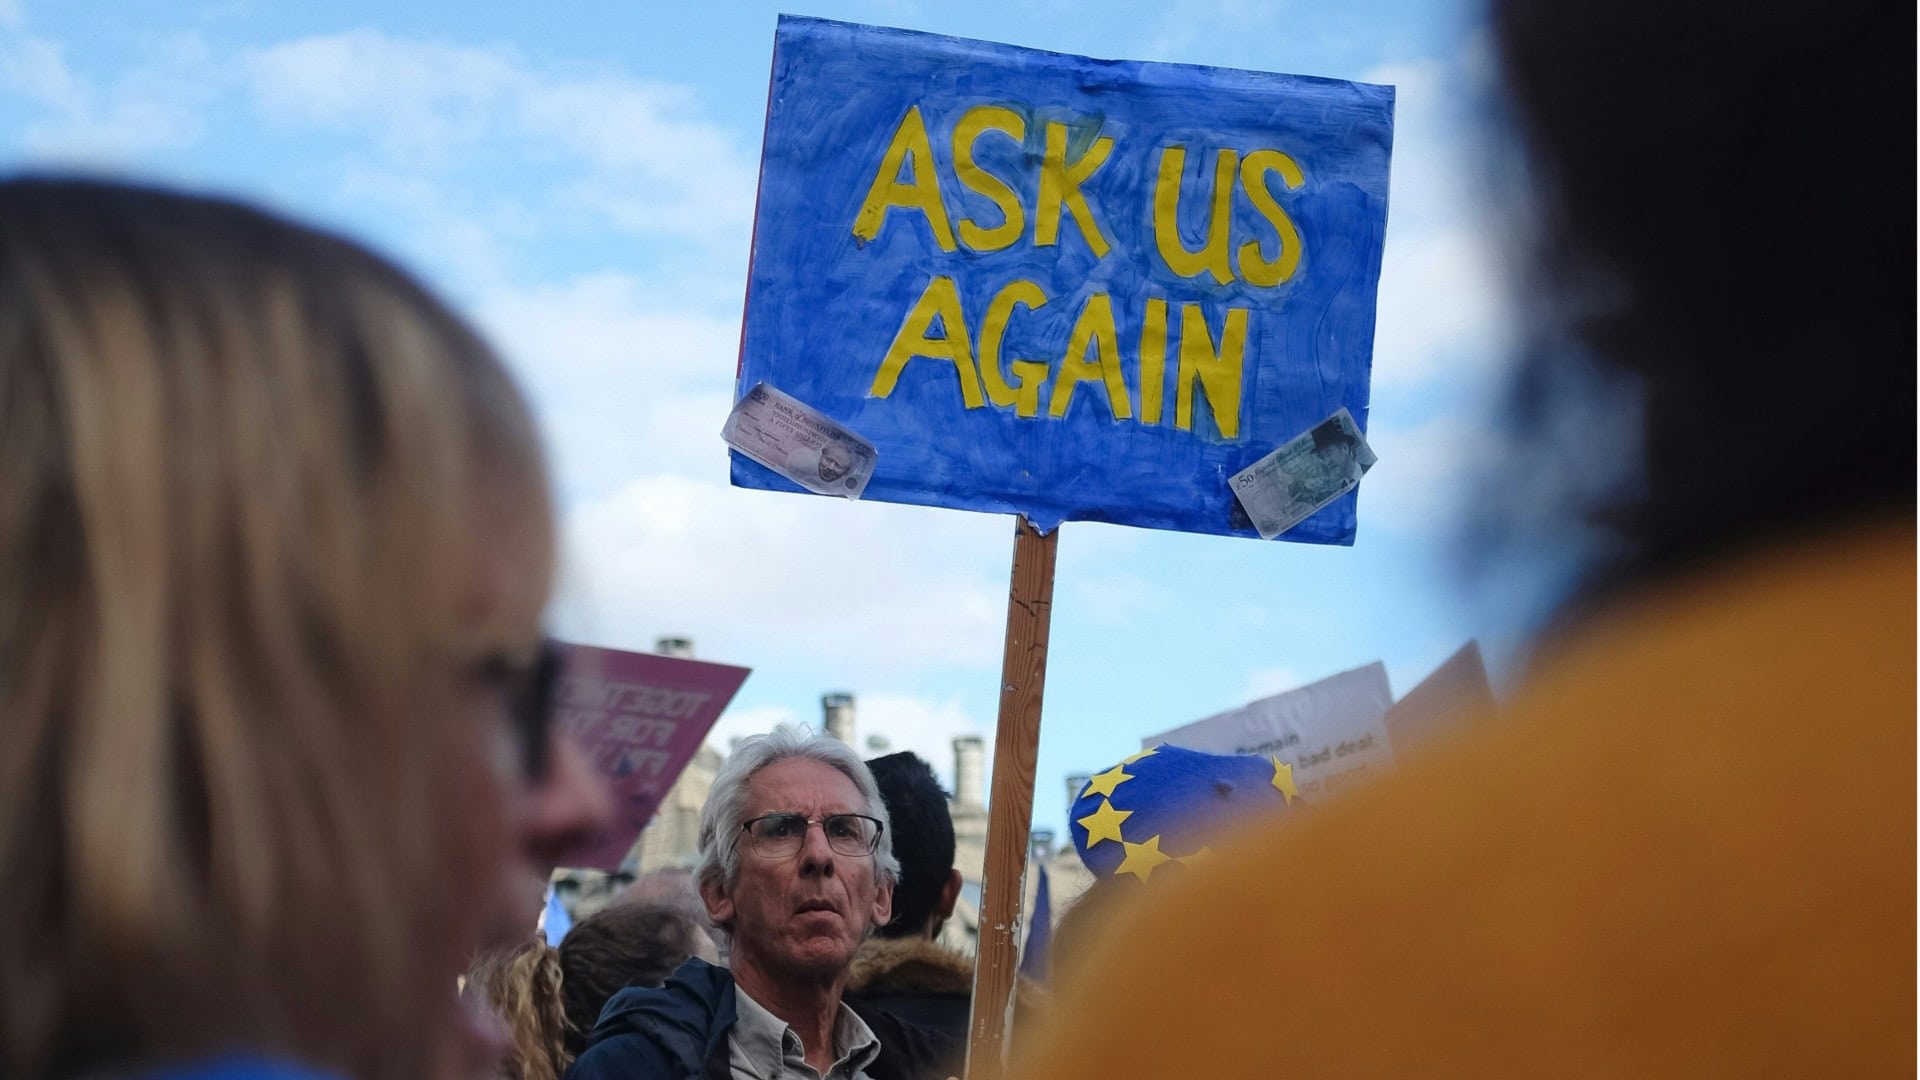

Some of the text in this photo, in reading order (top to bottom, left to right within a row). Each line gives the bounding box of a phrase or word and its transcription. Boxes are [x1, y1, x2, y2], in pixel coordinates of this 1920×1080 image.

[853, 104, 1305, 287] ASK US
[869, 276, 1248, 439] AGAIN
[1299, 746, 1330, 768] bad
